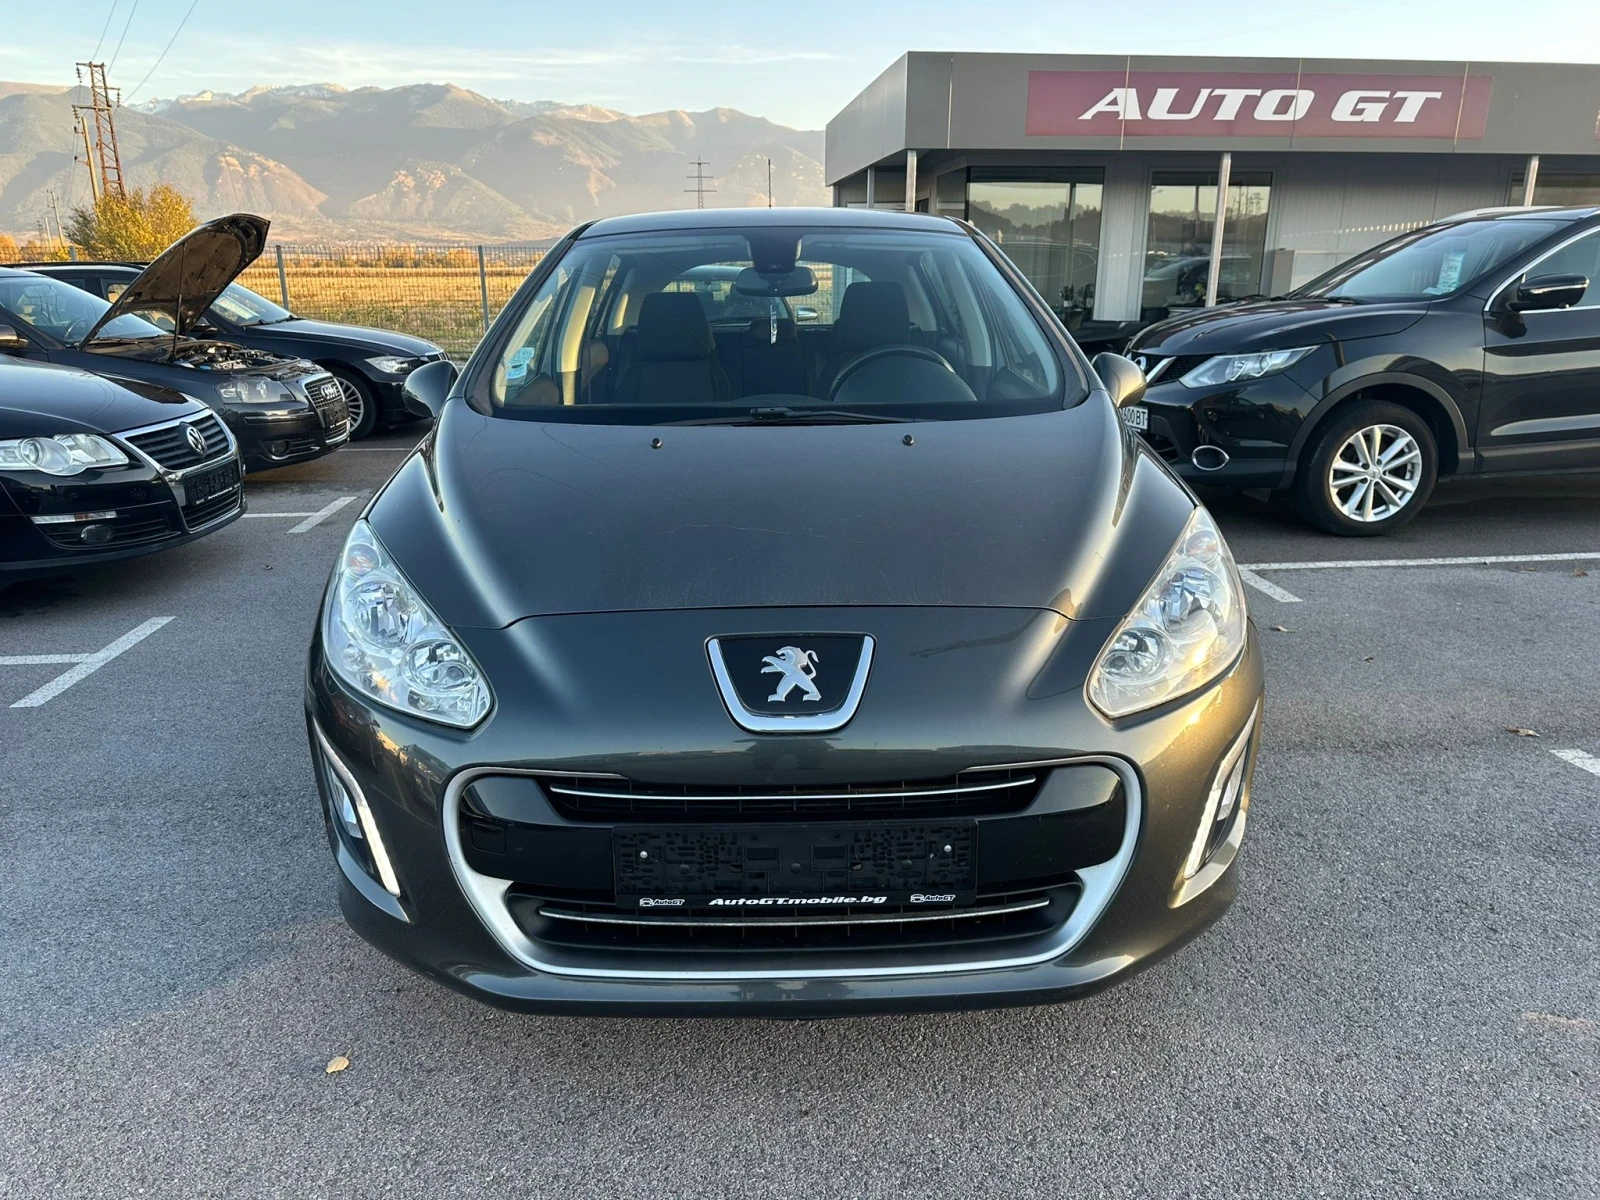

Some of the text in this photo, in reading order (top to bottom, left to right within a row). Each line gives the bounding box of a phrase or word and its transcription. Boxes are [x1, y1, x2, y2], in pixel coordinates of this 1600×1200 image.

[1077, 87, 1443, 123] AUTO GT
[653, 898, 685, 906] AutoGT
[708, 896, 888, 906] AutoGT.mobile.bg
[924, 894, 956, 902] AutoGT
